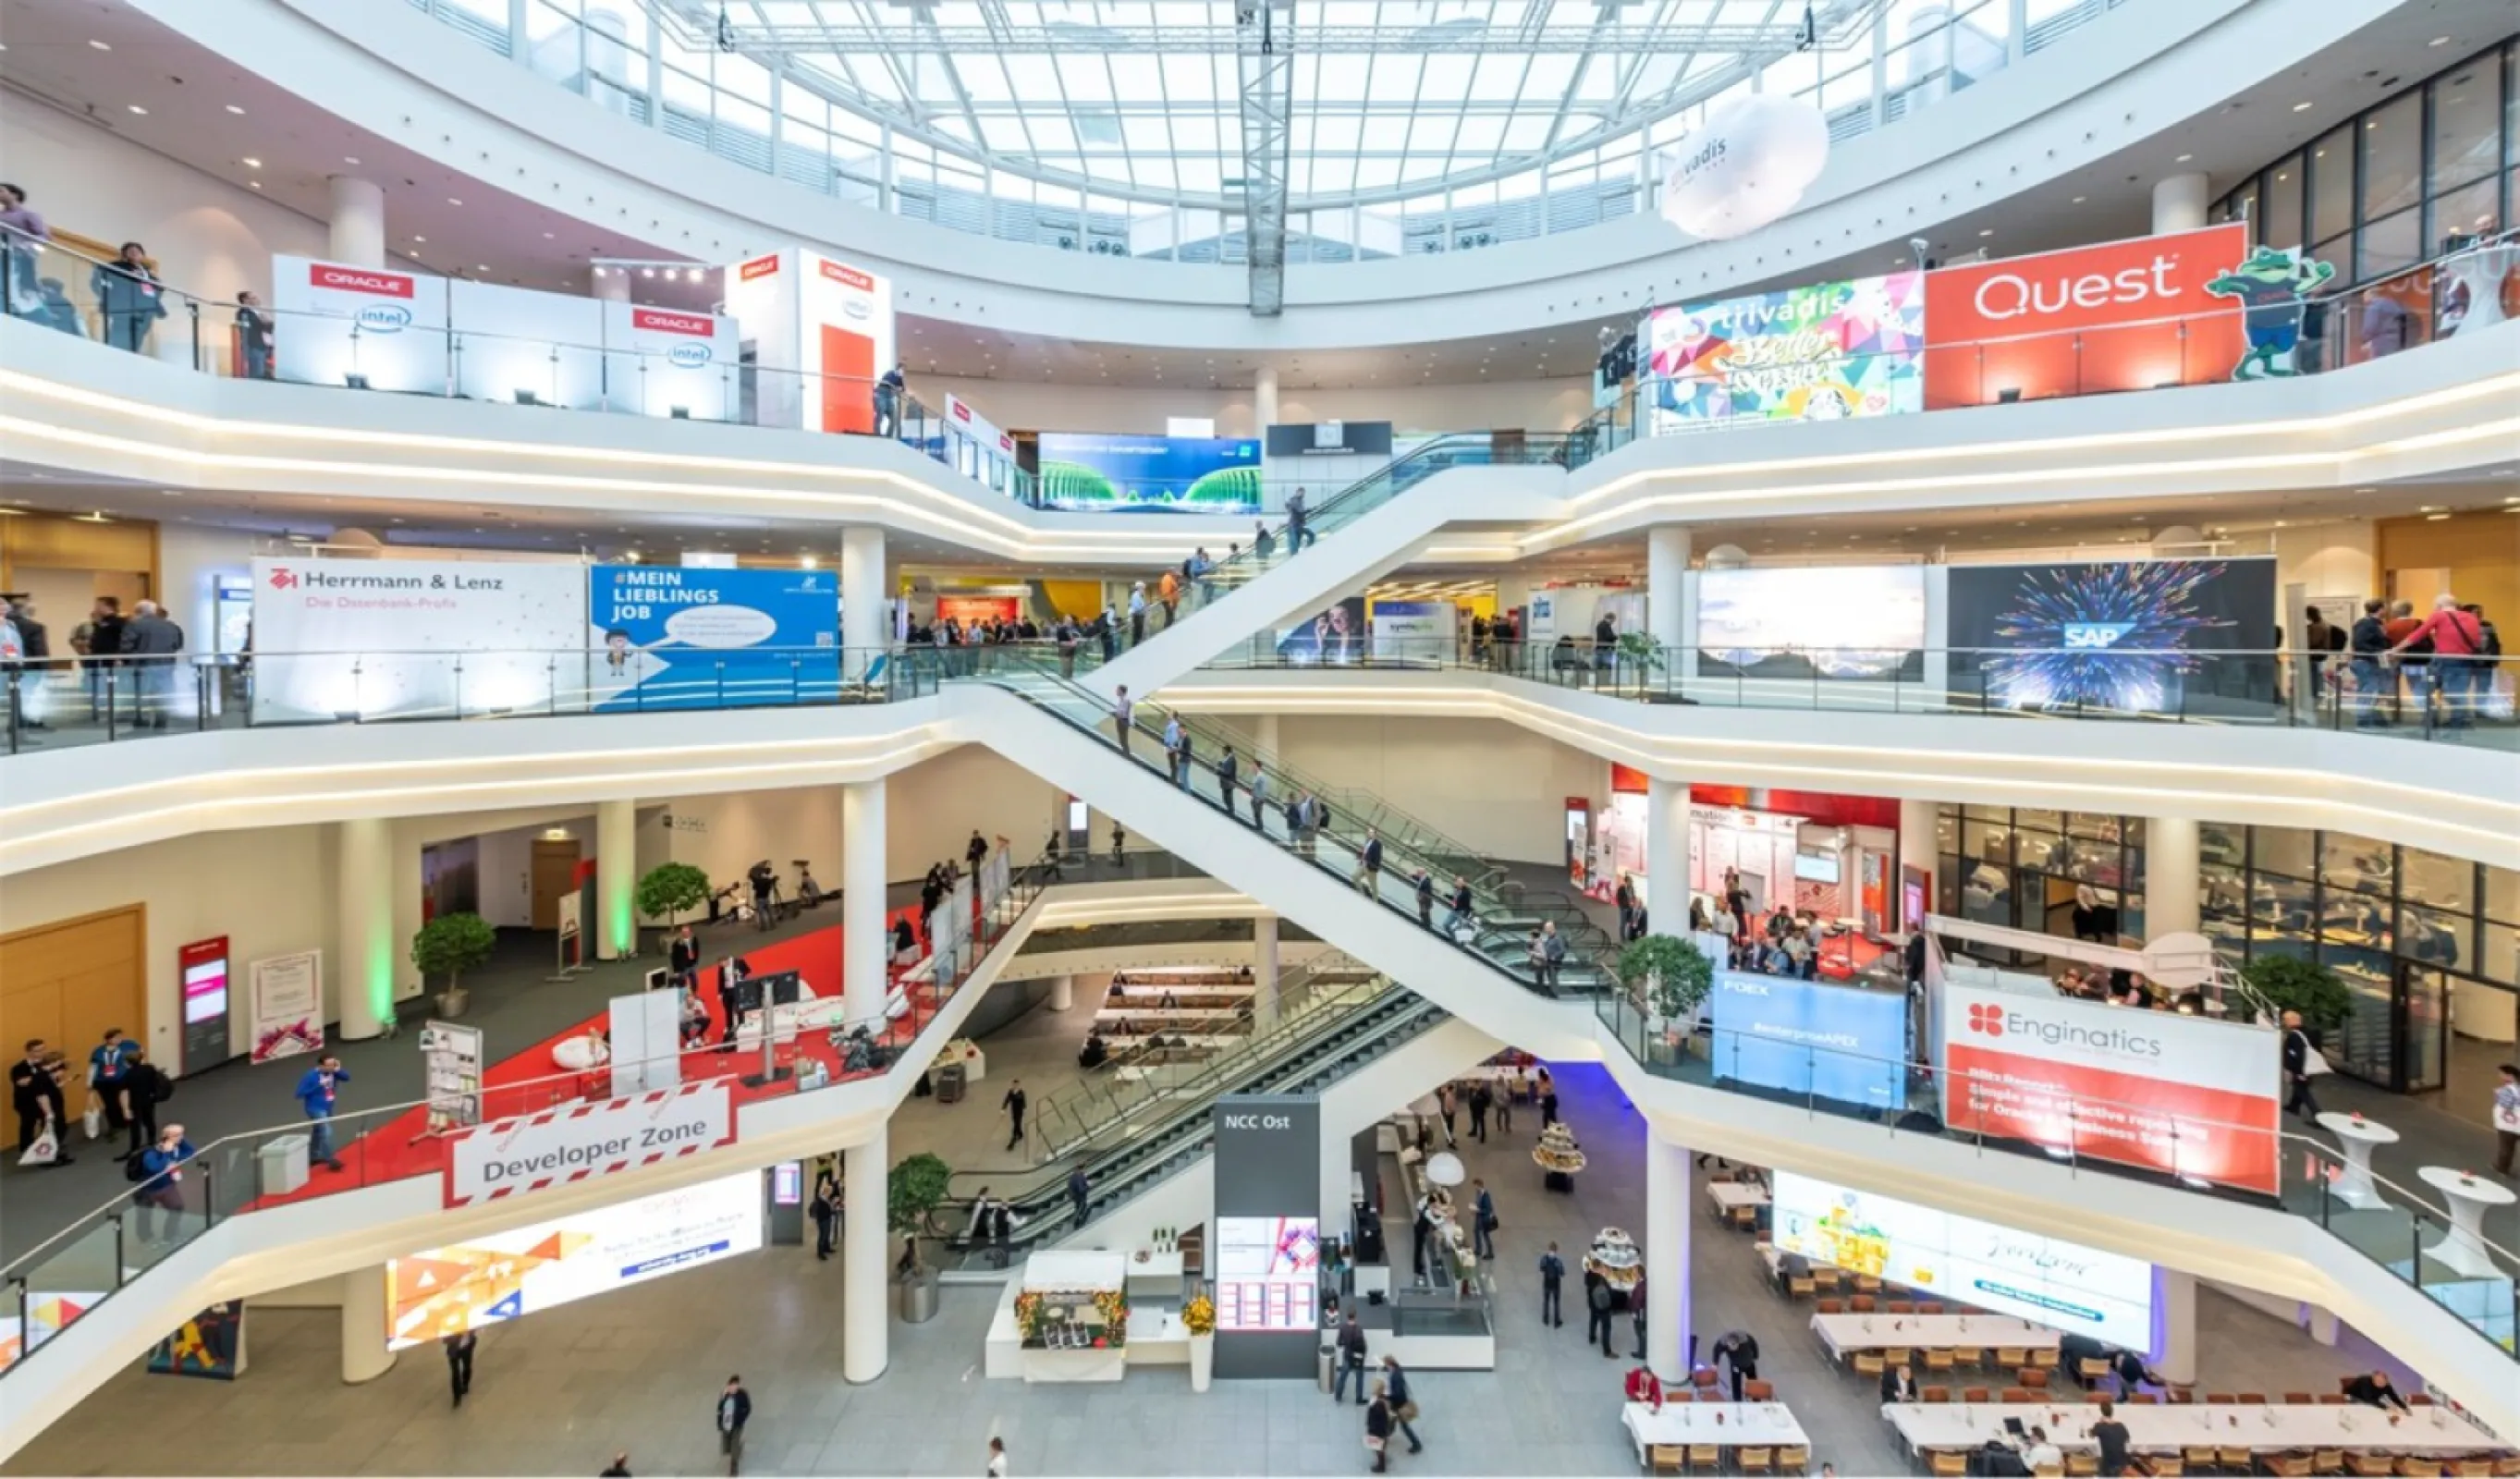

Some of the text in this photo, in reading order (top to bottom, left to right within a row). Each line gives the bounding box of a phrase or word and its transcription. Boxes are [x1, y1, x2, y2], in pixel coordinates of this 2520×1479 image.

[324, 272, 400, 292] ORACLE
[1975, 254, 2181, 319] Quest
[361, 308, 403, 324] intel
[1719, 287, 1847, 328] trivadis
[644, 315, 703, 332] ORACLE
[673, 345, 705, 360] intel
[305, 572, 504, 590] Herrmann & Lenz
[615, 570, 681, 586] #MEIN
[305, 596, 331, 608] Die
[613, 588, 719, 604] LIEBLINGS
[611, 605, 652, 623] JOB
[2065, 628, 2118, 648] SAP
[1723, 980, 1769, 996] FOEX
[2007, 1012, 2161, 1057] Enginatics
[1968, 1082, 2020, 1104] Simple
[1225, 1114, 1291, 1130] NCC Ost
[483, 1136, 632, 1182] Developer
[640, 1119, 707, 1148] Zone
